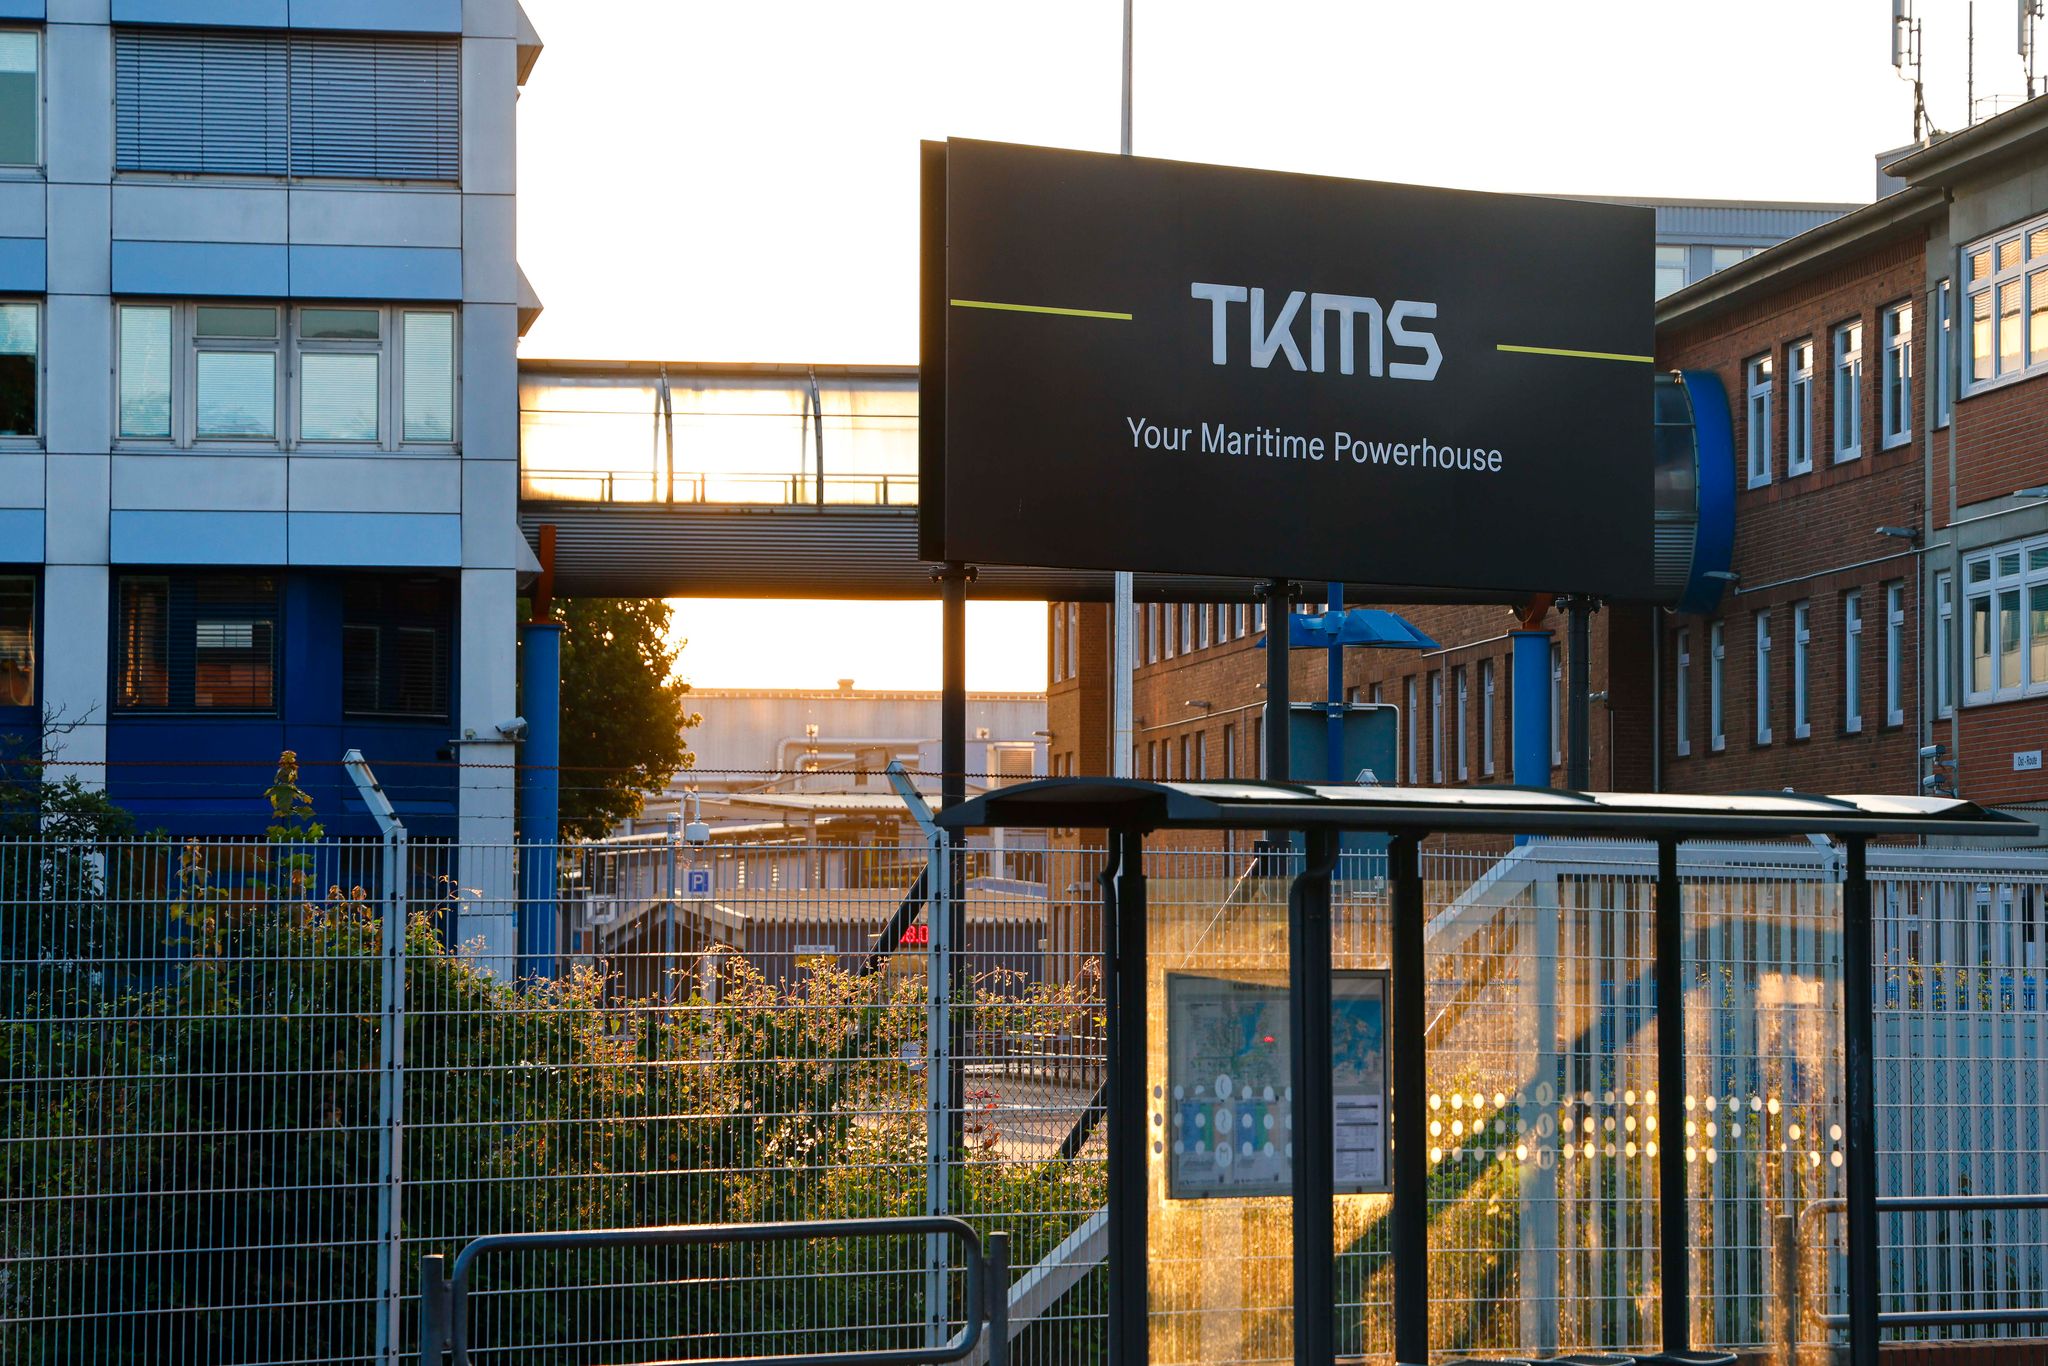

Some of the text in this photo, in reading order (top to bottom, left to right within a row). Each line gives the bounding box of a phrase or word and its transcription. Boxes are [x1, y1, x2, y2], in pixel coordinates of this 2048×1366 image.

[1191, 282, 1443, 381] TKMS
[1127, 416, 1503, 473] Your Maritime Powerhouse
